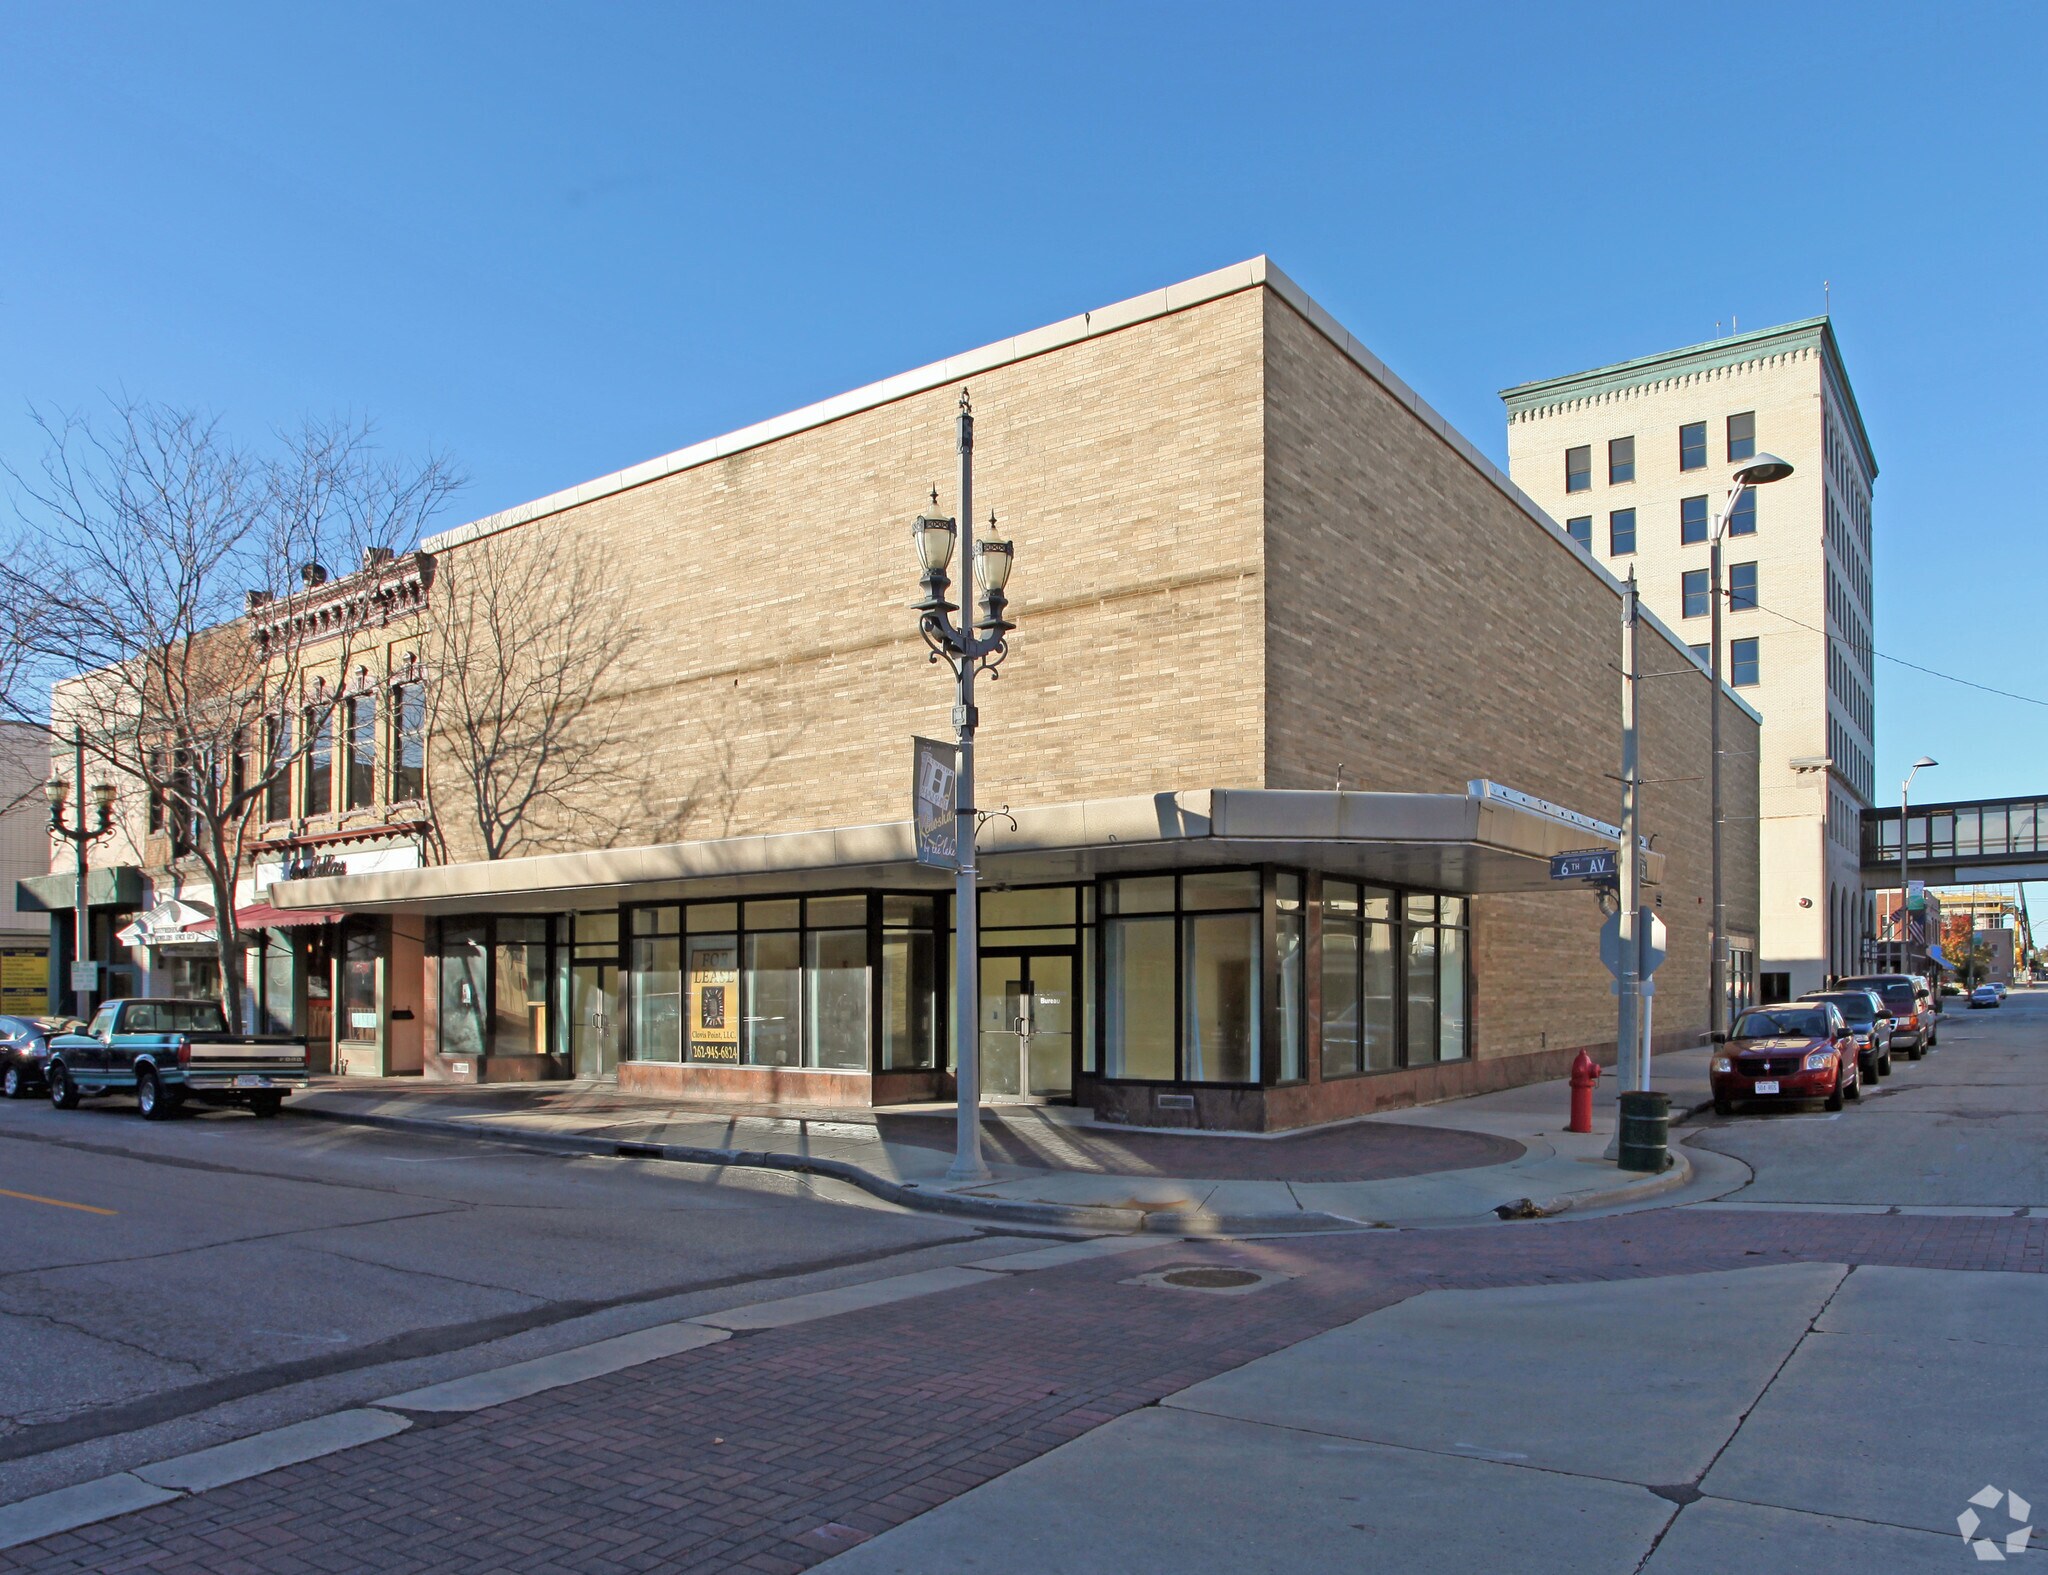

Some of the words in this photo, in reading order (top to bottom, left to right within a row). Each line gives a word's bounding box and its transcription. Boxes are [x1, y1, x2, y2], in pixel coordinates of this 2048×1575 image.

[1561, 862, 1569, 876] 6
[1571, 863, 1580, 871] TH
[1589, 858, 1606, 874] AV
[702, 952, 728, 968] FOR
[694, 968, 735, 984] LEASE
[692, 1030, 707, 1039] Clovis
[707, 1031, 723, 1040] Point,
[693, 1045, 737, 1059] 262-945-6824
